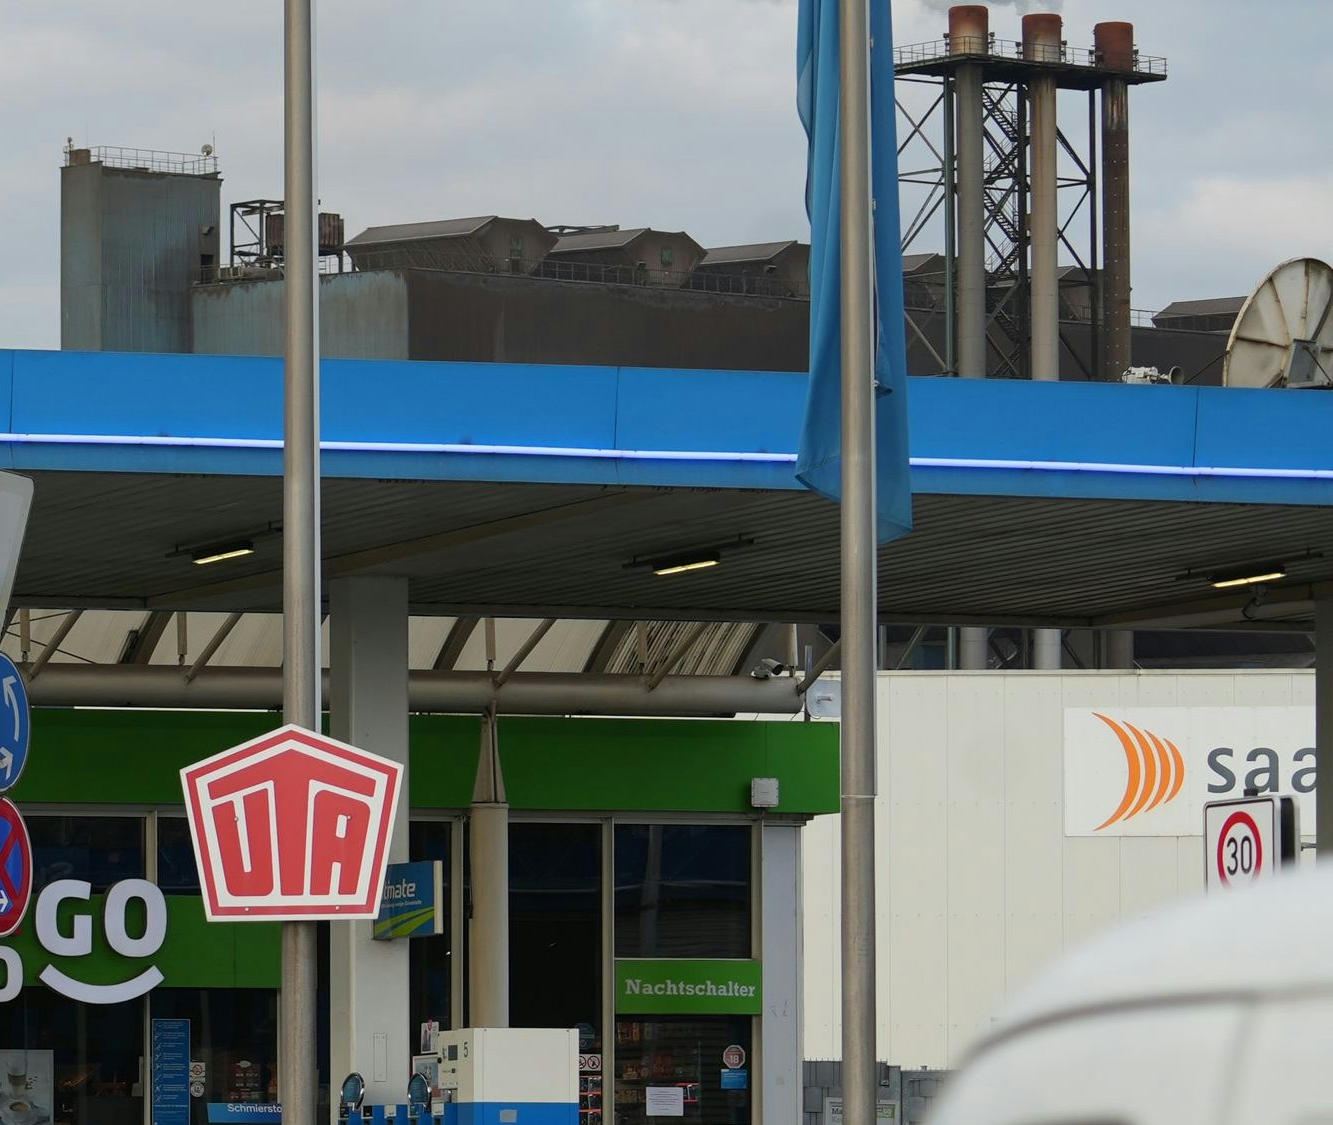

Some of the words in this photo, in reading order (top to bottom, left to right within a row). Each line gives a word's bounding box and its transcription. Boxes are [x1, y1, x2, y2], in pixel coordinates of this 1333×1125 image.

[1207, 747, 1317, 794] saa
[207, 748, 377, 897] UTA
[1226, 836, 1253, 876] 30
[35, 879, 168, 958] GO
[625, 979, 756, 997] Nachtschalter
[463, 1041, 469, 1058] 5
[227, 1103, 283, 1113] Schmiersto
